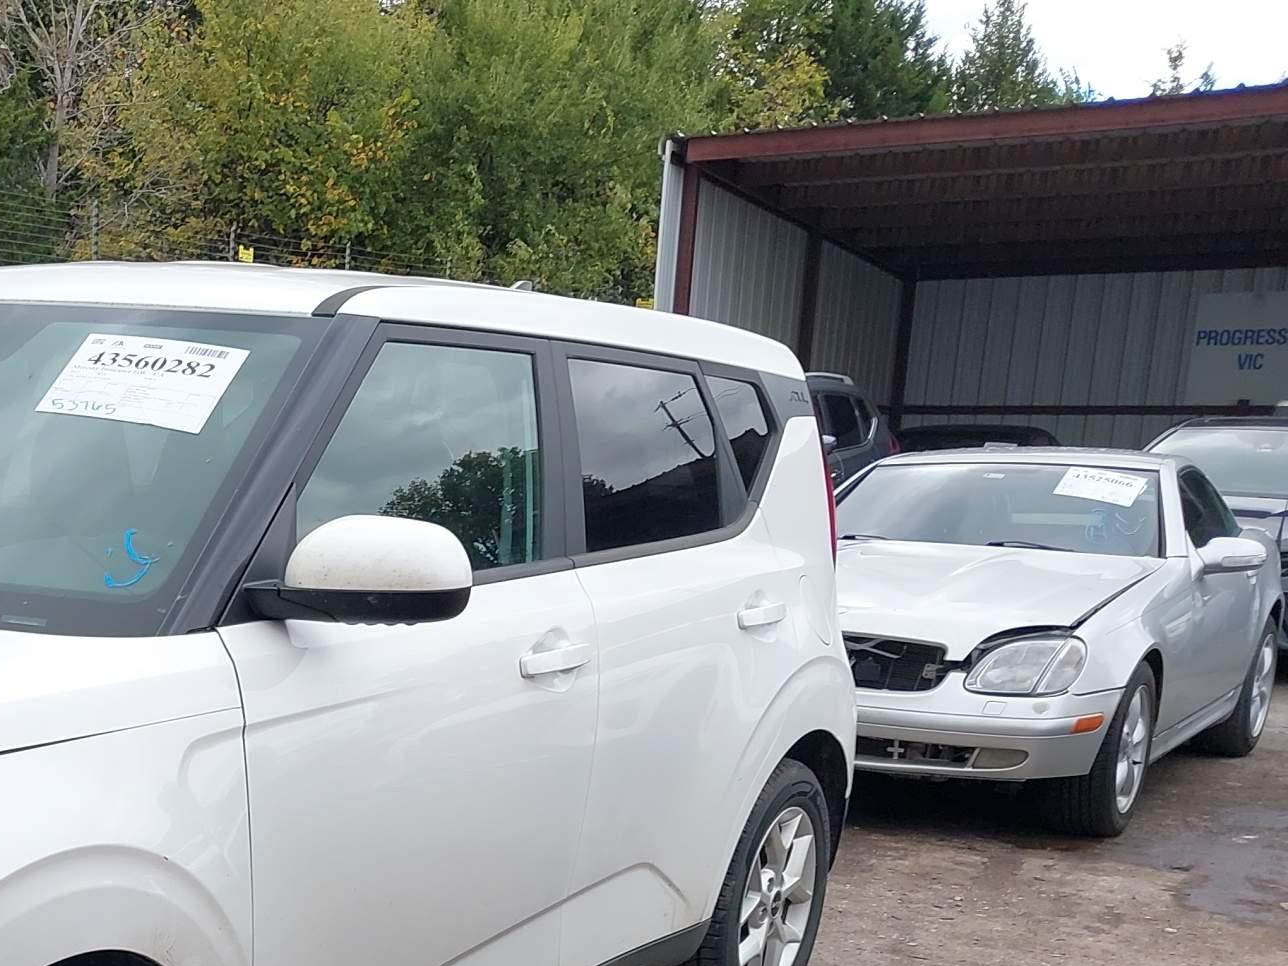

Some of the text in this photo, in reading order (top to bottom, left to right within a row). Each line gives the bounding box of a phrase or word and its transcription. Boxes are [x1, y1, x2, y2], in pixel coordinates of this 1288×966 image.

[1196, 328, 1288, 346] PROGRESS
[87, 351, 216, 378] 43560282
[1238, 353, 1264, 370] VIC
